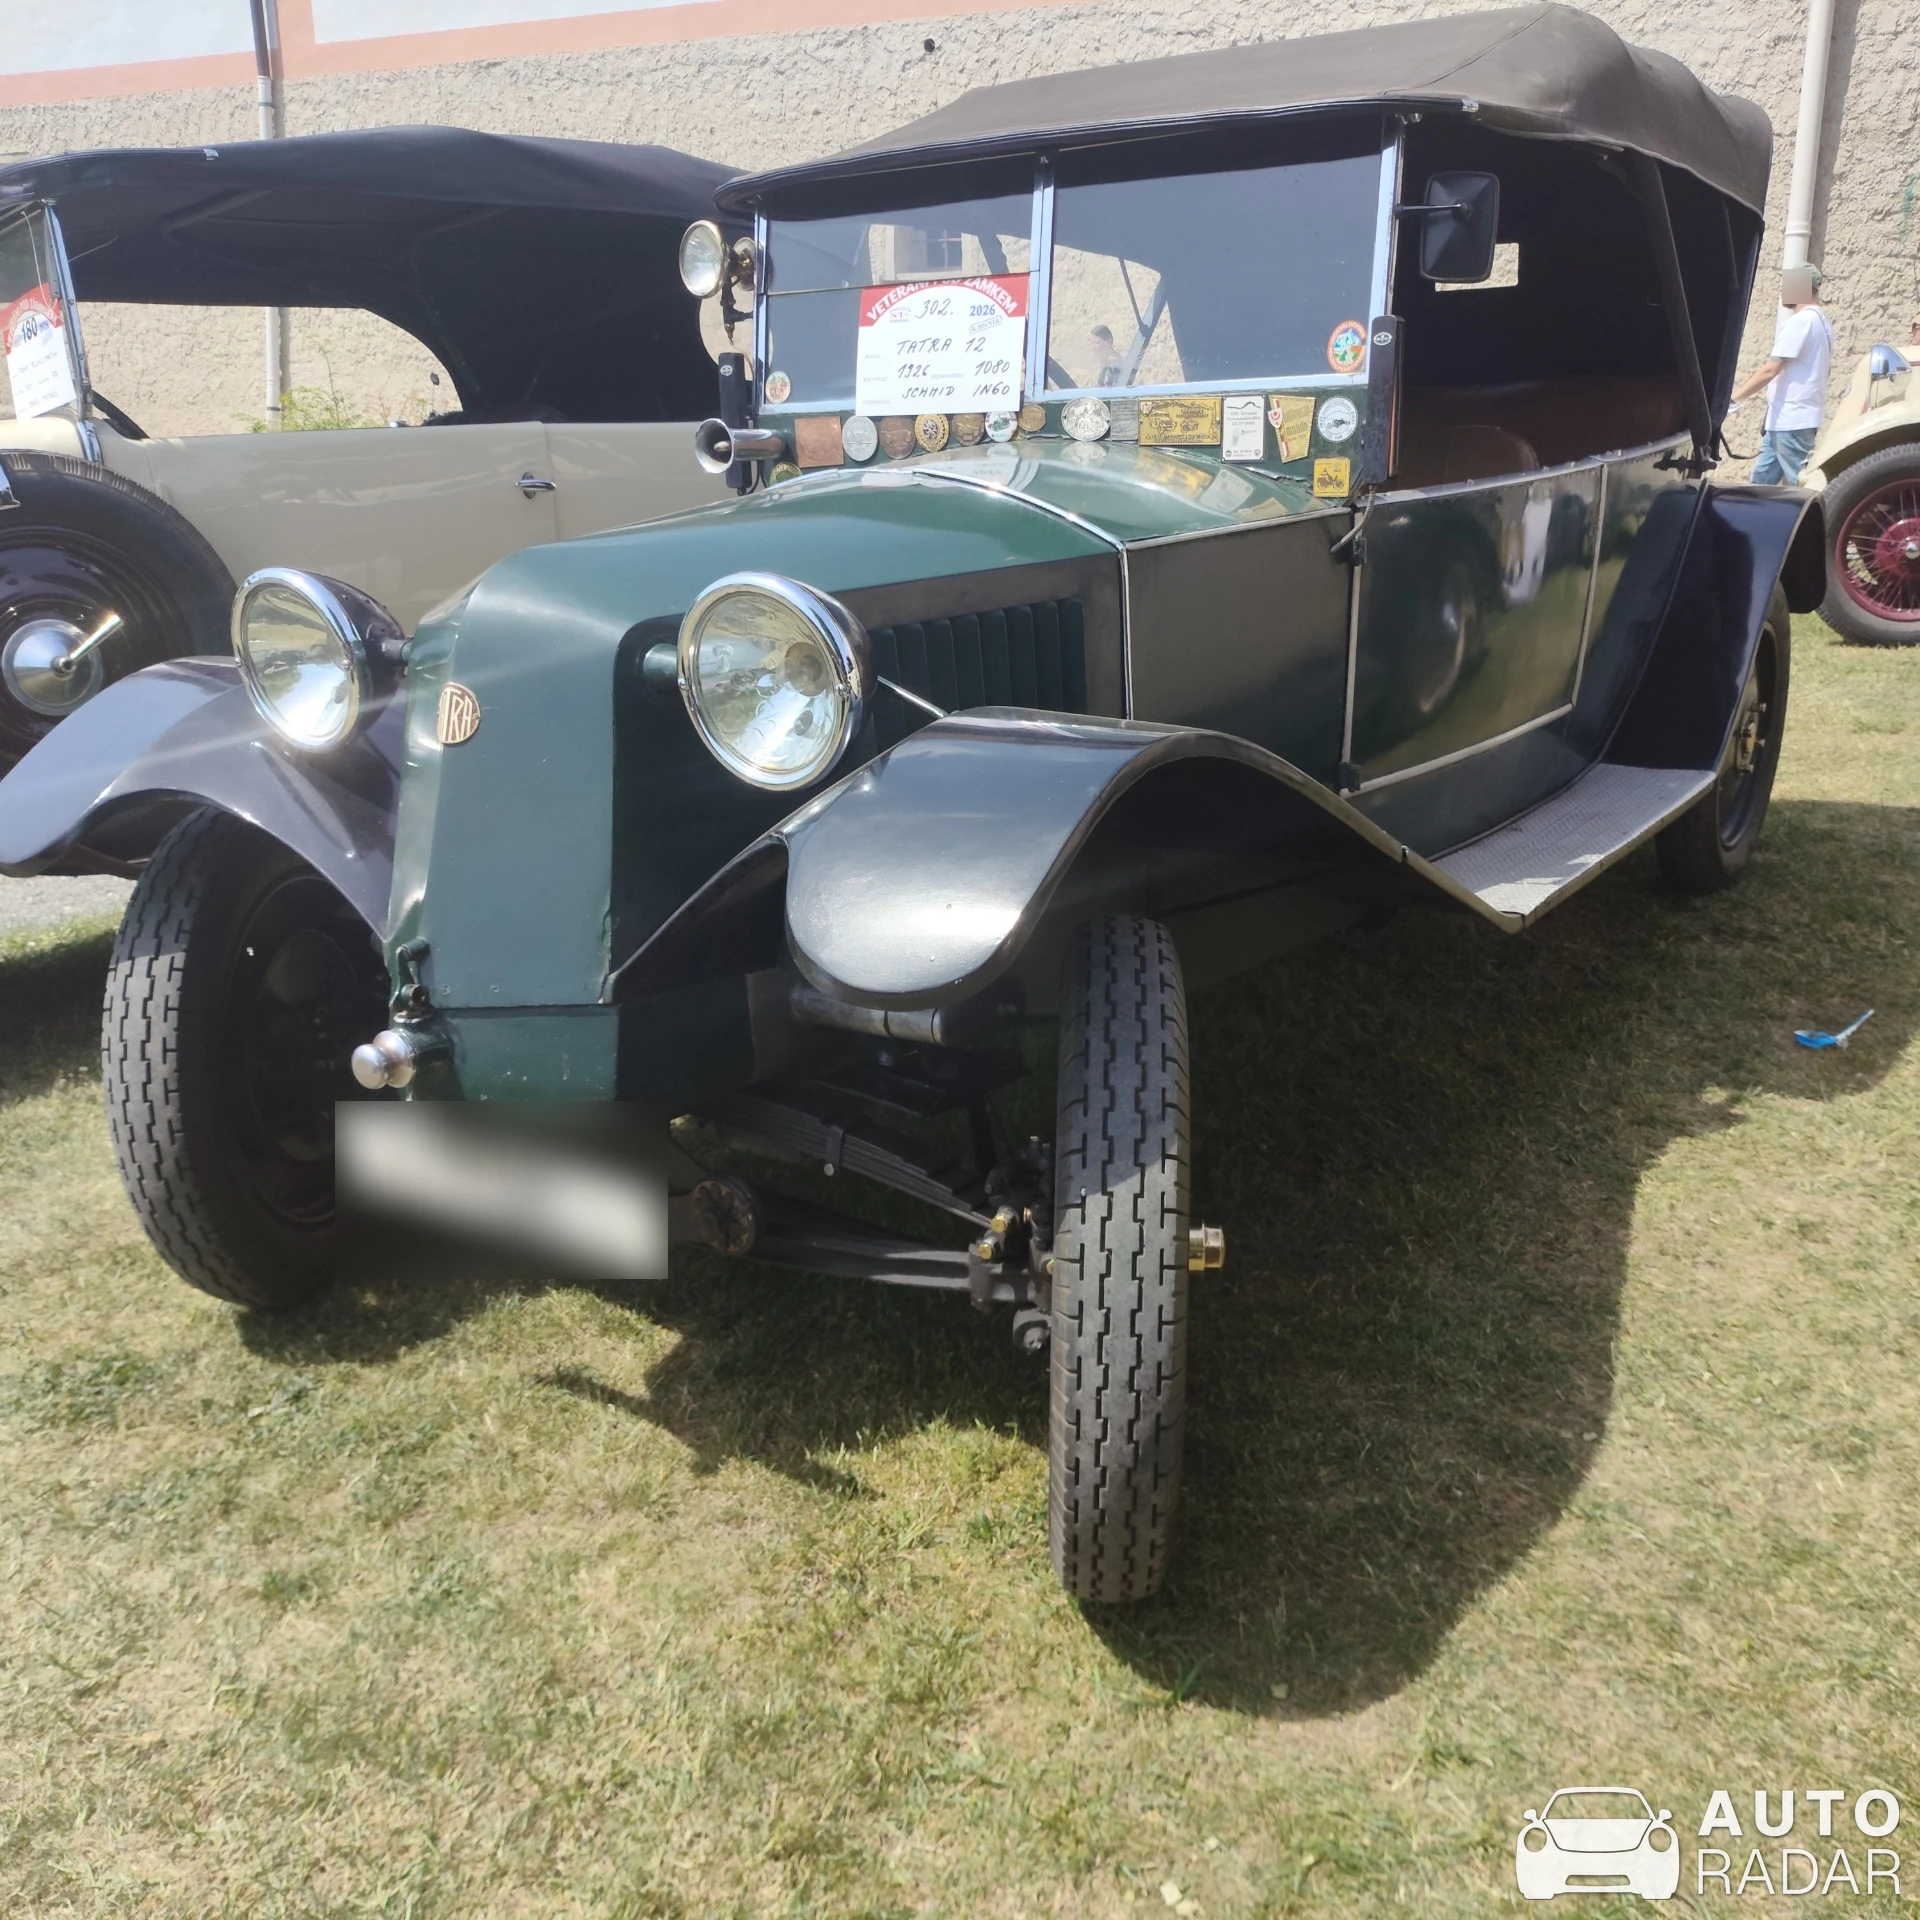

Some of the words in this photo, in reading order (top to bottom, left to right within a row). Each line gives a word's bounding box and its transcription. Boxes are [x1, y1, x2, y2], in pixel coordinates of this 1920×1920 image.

[970, 304, 996, 317] 2026
[21, 317, 38, 343] 180
[897, 338, 953, 355] TATRA
[965, 337, 987, 353] 12
[897, 363, 930, 379] 1926
[974, 359, 1010, 376] 1080
